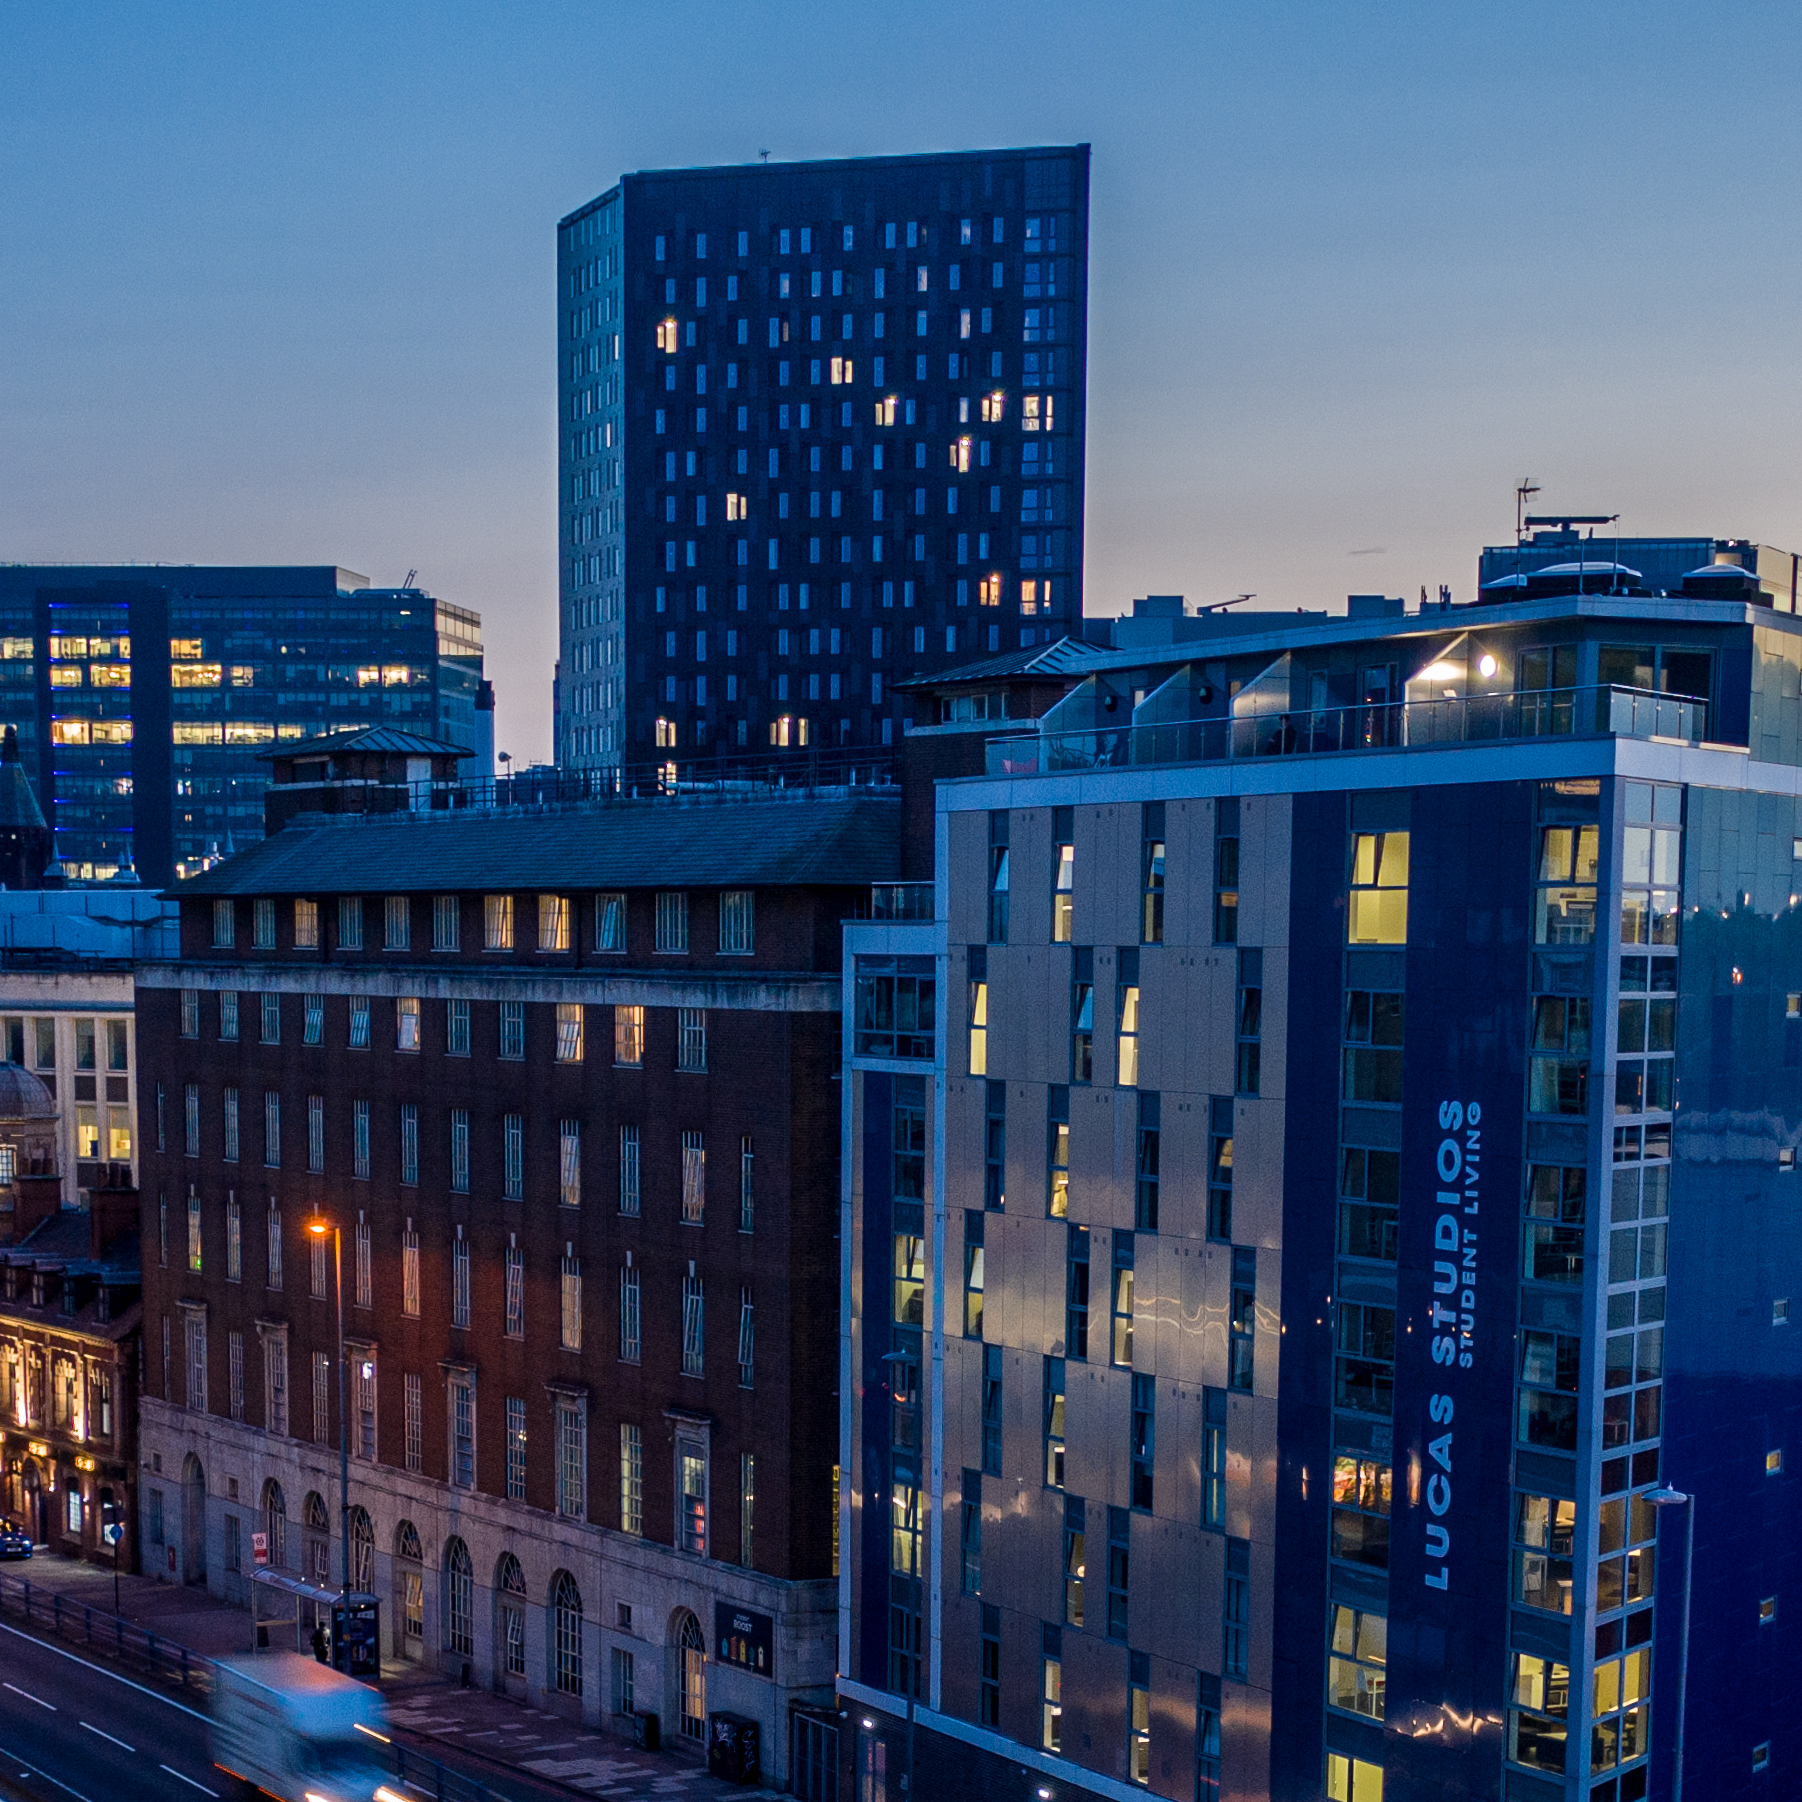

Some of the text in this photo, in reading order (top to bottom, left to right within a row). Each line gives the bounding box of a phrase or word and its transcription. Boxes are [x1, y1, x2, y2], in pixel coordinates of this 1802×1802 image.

[1424, 1100, 1463, 1591] LUCAS STUDIOS
[1459, 1101, 1481, 1369] STUDENT LIVING
